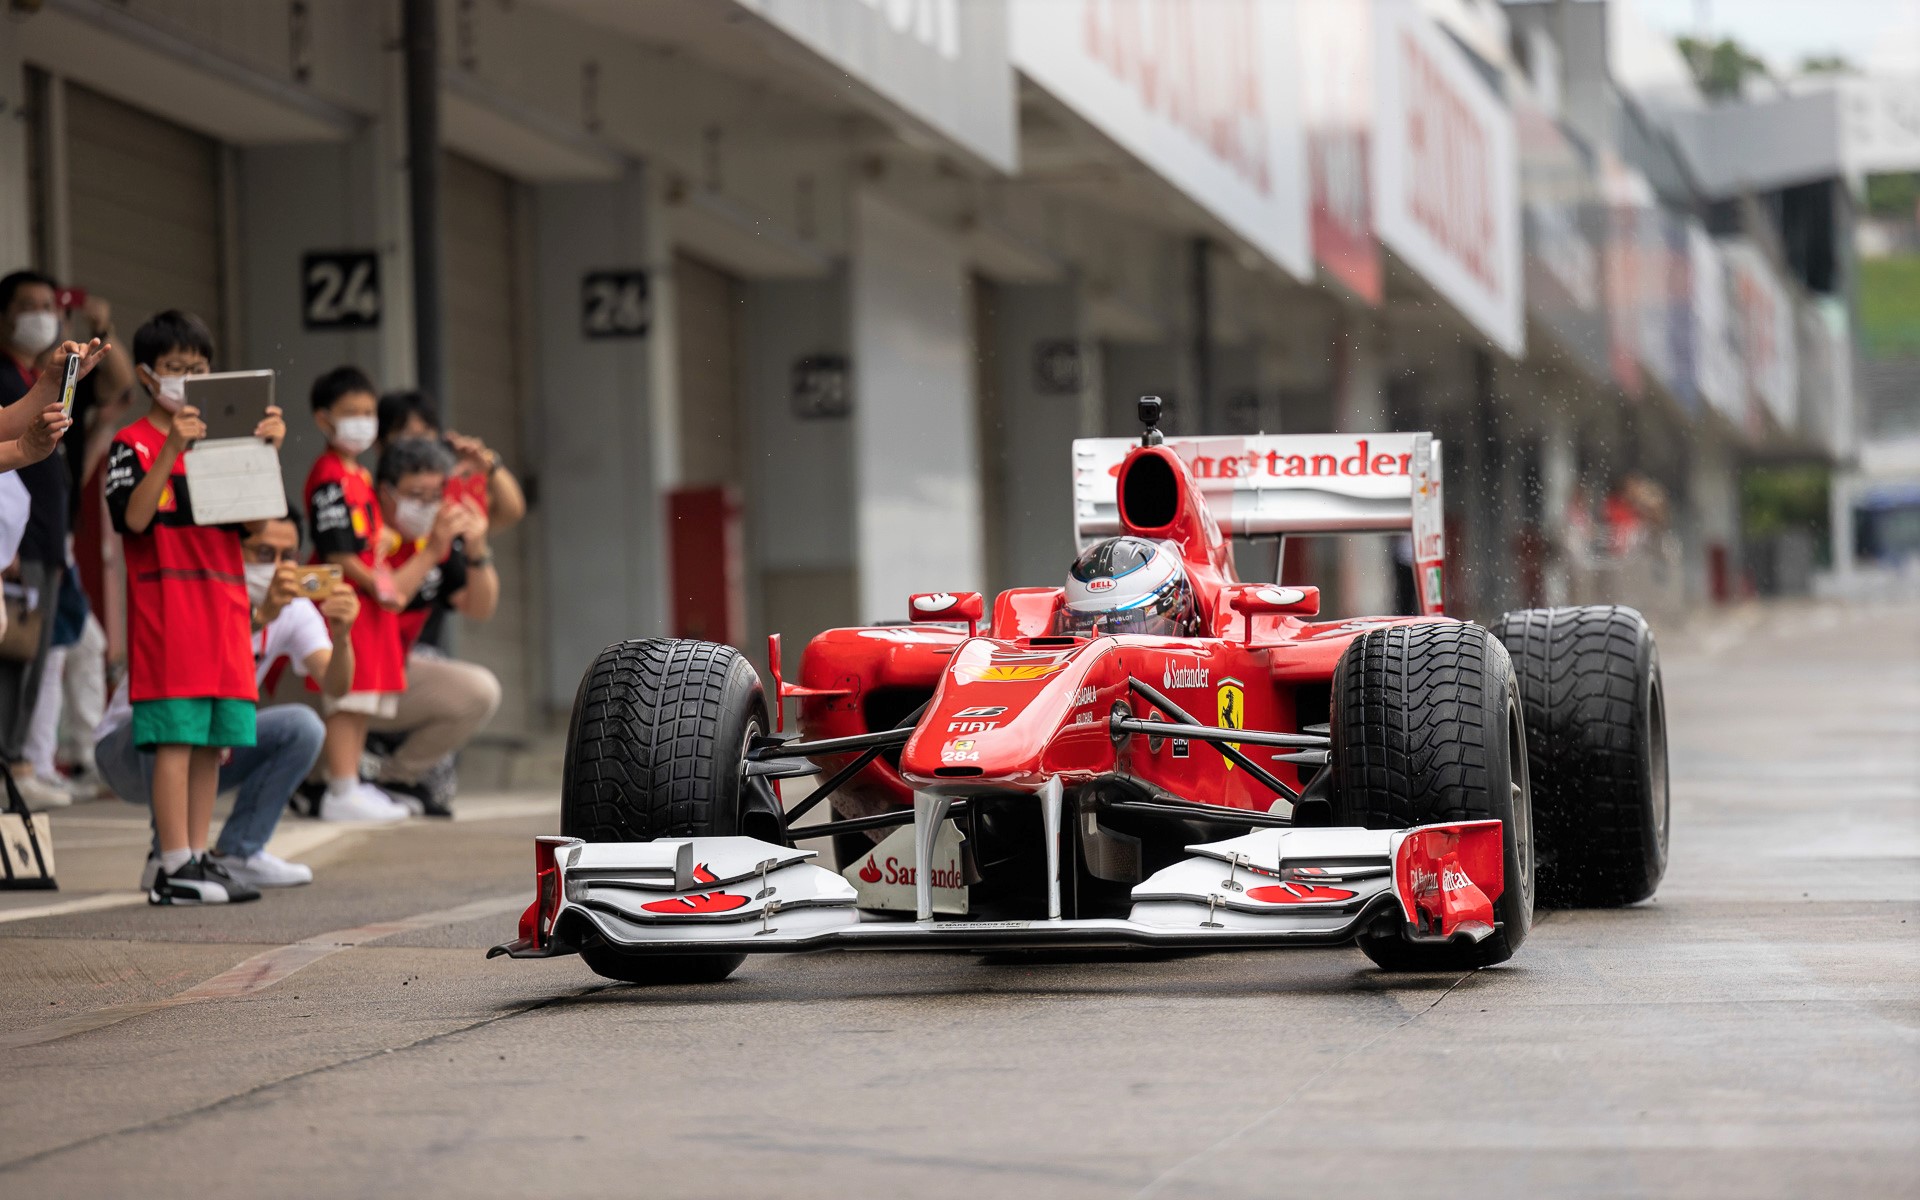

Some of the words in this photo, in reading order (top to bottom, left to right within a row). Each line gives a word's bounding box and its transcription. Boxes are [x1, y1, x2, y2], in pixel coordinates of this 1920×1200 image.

[309, 261, 375, 321] 24
[1090, 580, 1112, 589] BELL
[1171, 656, 1209, 690] Santander
[946, 721, 1001, 733] FIAT
[941, 750, 980, 762] 284
[885, 856, 965, 890] Sanande
